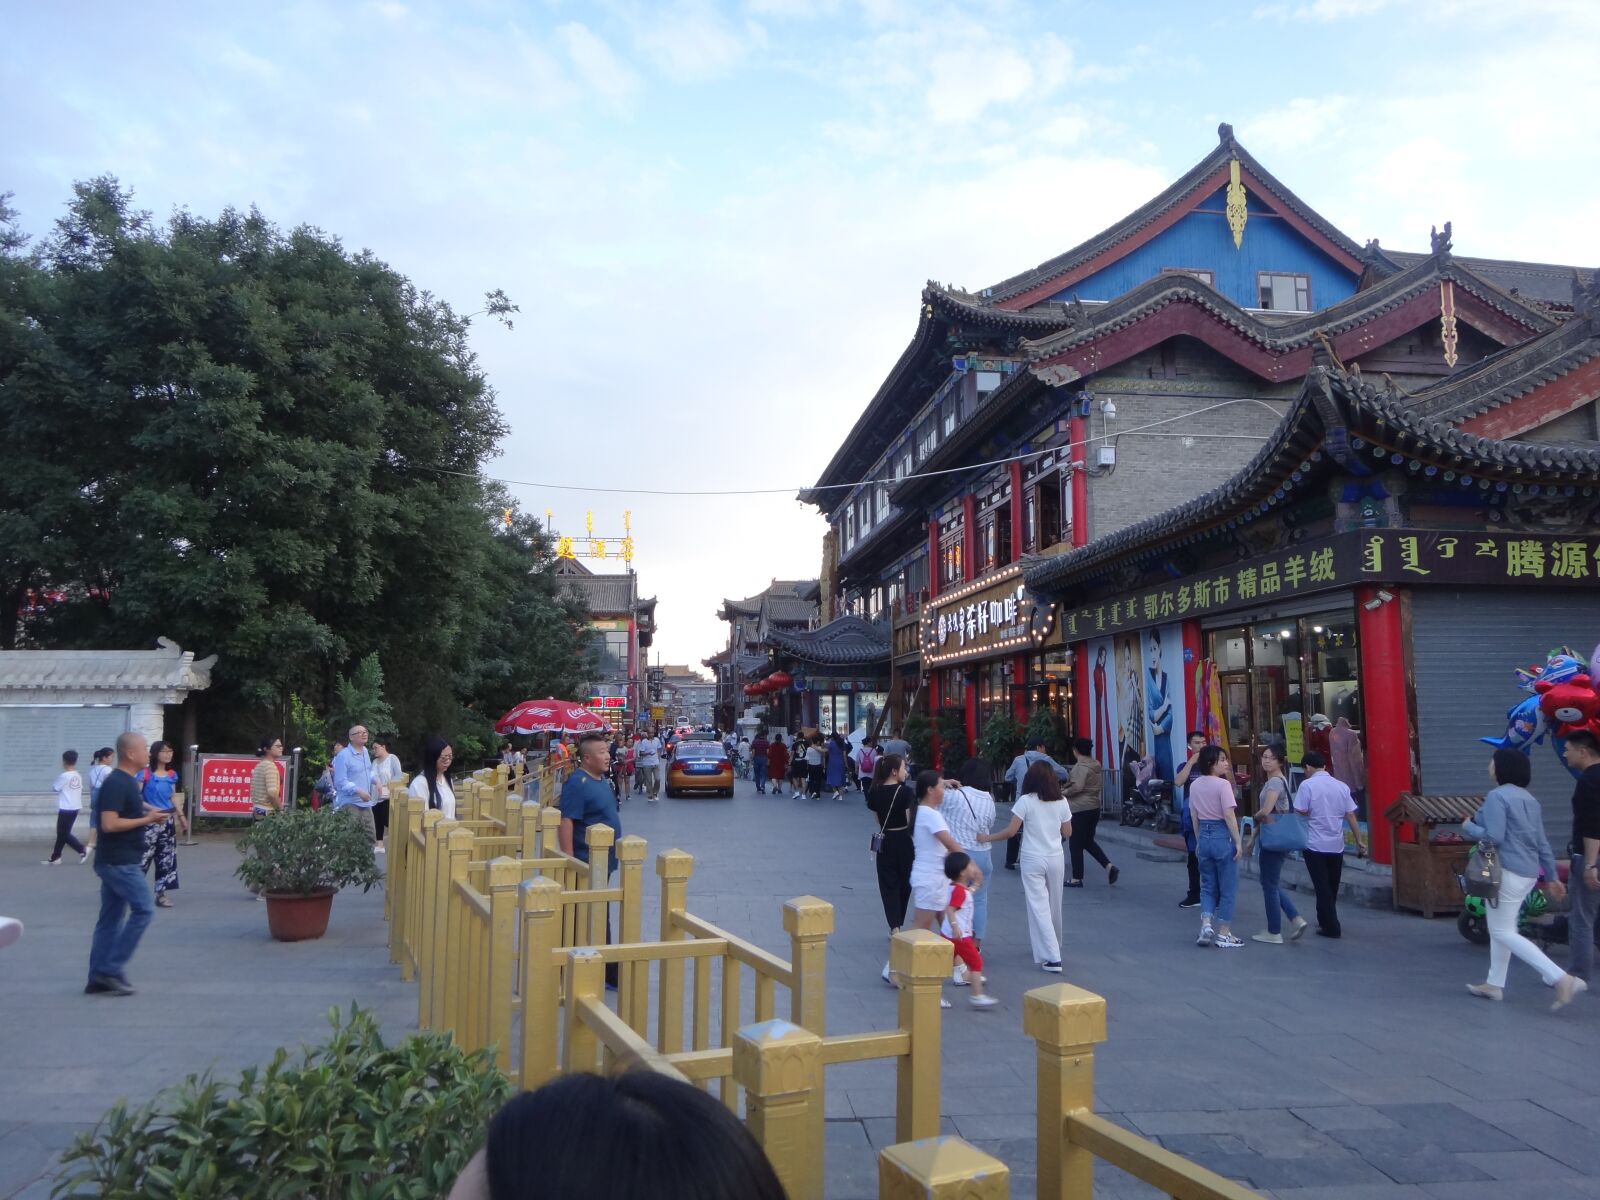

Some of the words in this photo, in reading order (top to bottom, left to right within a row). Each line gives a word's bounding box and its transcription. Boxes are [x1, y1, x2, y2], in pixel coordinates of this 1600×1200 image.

[1143, 576, 1231, 620] 鄂尔多斯市
[1237, 547, 1336, 599] 精品羊绒
[1506, 540, 1600, 578] 腾源
